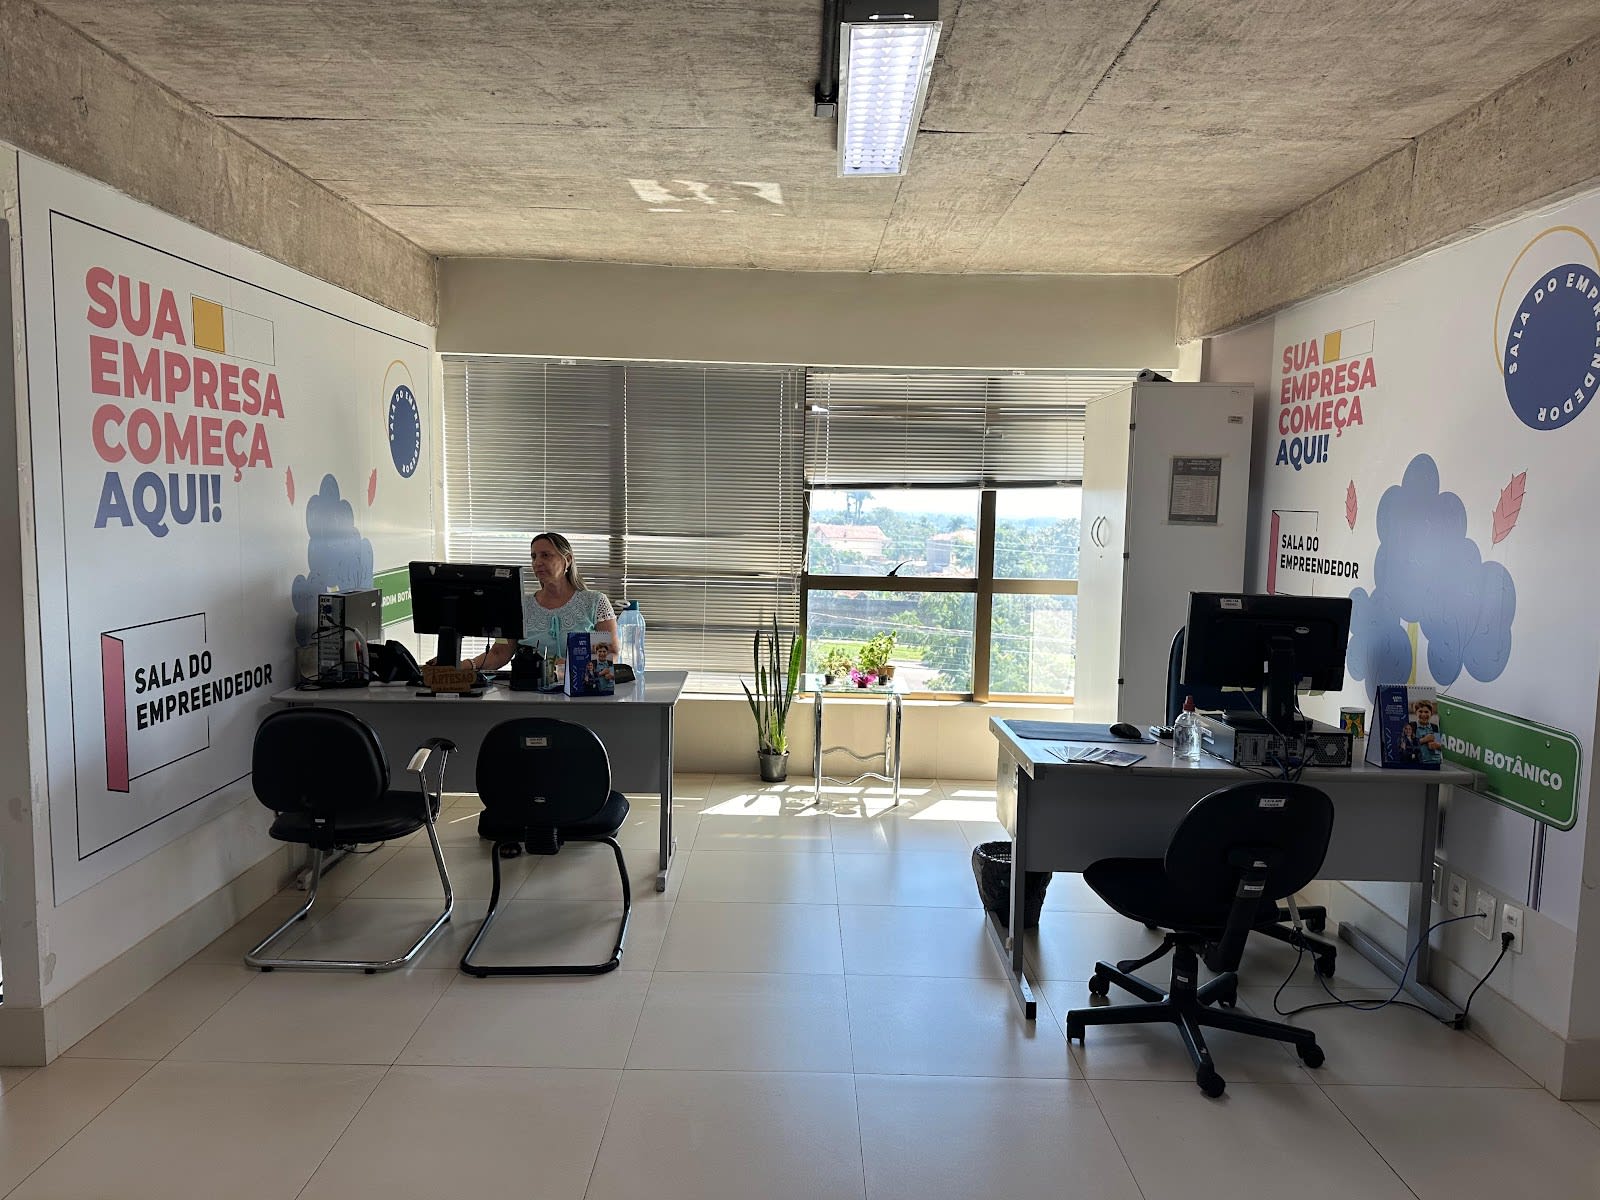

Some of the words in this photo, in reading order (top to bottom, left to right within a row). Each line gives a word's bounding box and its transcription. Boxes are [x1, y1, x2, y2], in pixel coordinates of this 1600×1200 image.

[85, 266, 187, 346] SUA
[1508, 311, 1531, 375] SALA
[1534, 277, 1557, 304] DO
[89, 334, 285, 418] EMPRESA
[1281, 338, 1320, 375] SUA
[1280, 357, 1377, 405] EMPRESA
[1278, 395, 1364, 438] COMEÇA
[92, 403, 273, 483] COMEÇA
[1275, 434, 1330, 471] AQUI!
[94, 471, 222, 538] AQUI!
[1280, 554, 1359, 580] EMPREENDEDOR
[1281, 534, 1305, 551] SALA
[1306, 535, 1319, 552] DO
[381, 593, 397, 607] RDIM
[397, 587, 412, 602] BOTÂ
[135, 658, 185, 694] SALA
[189, 650, 212, 679] DO
[136, 663, 273, 730] EMPREENDEDOR
[1440, 733, 1481, 761] ARDIM
[1484, 750, 1563, 791] BOTÂNICO
